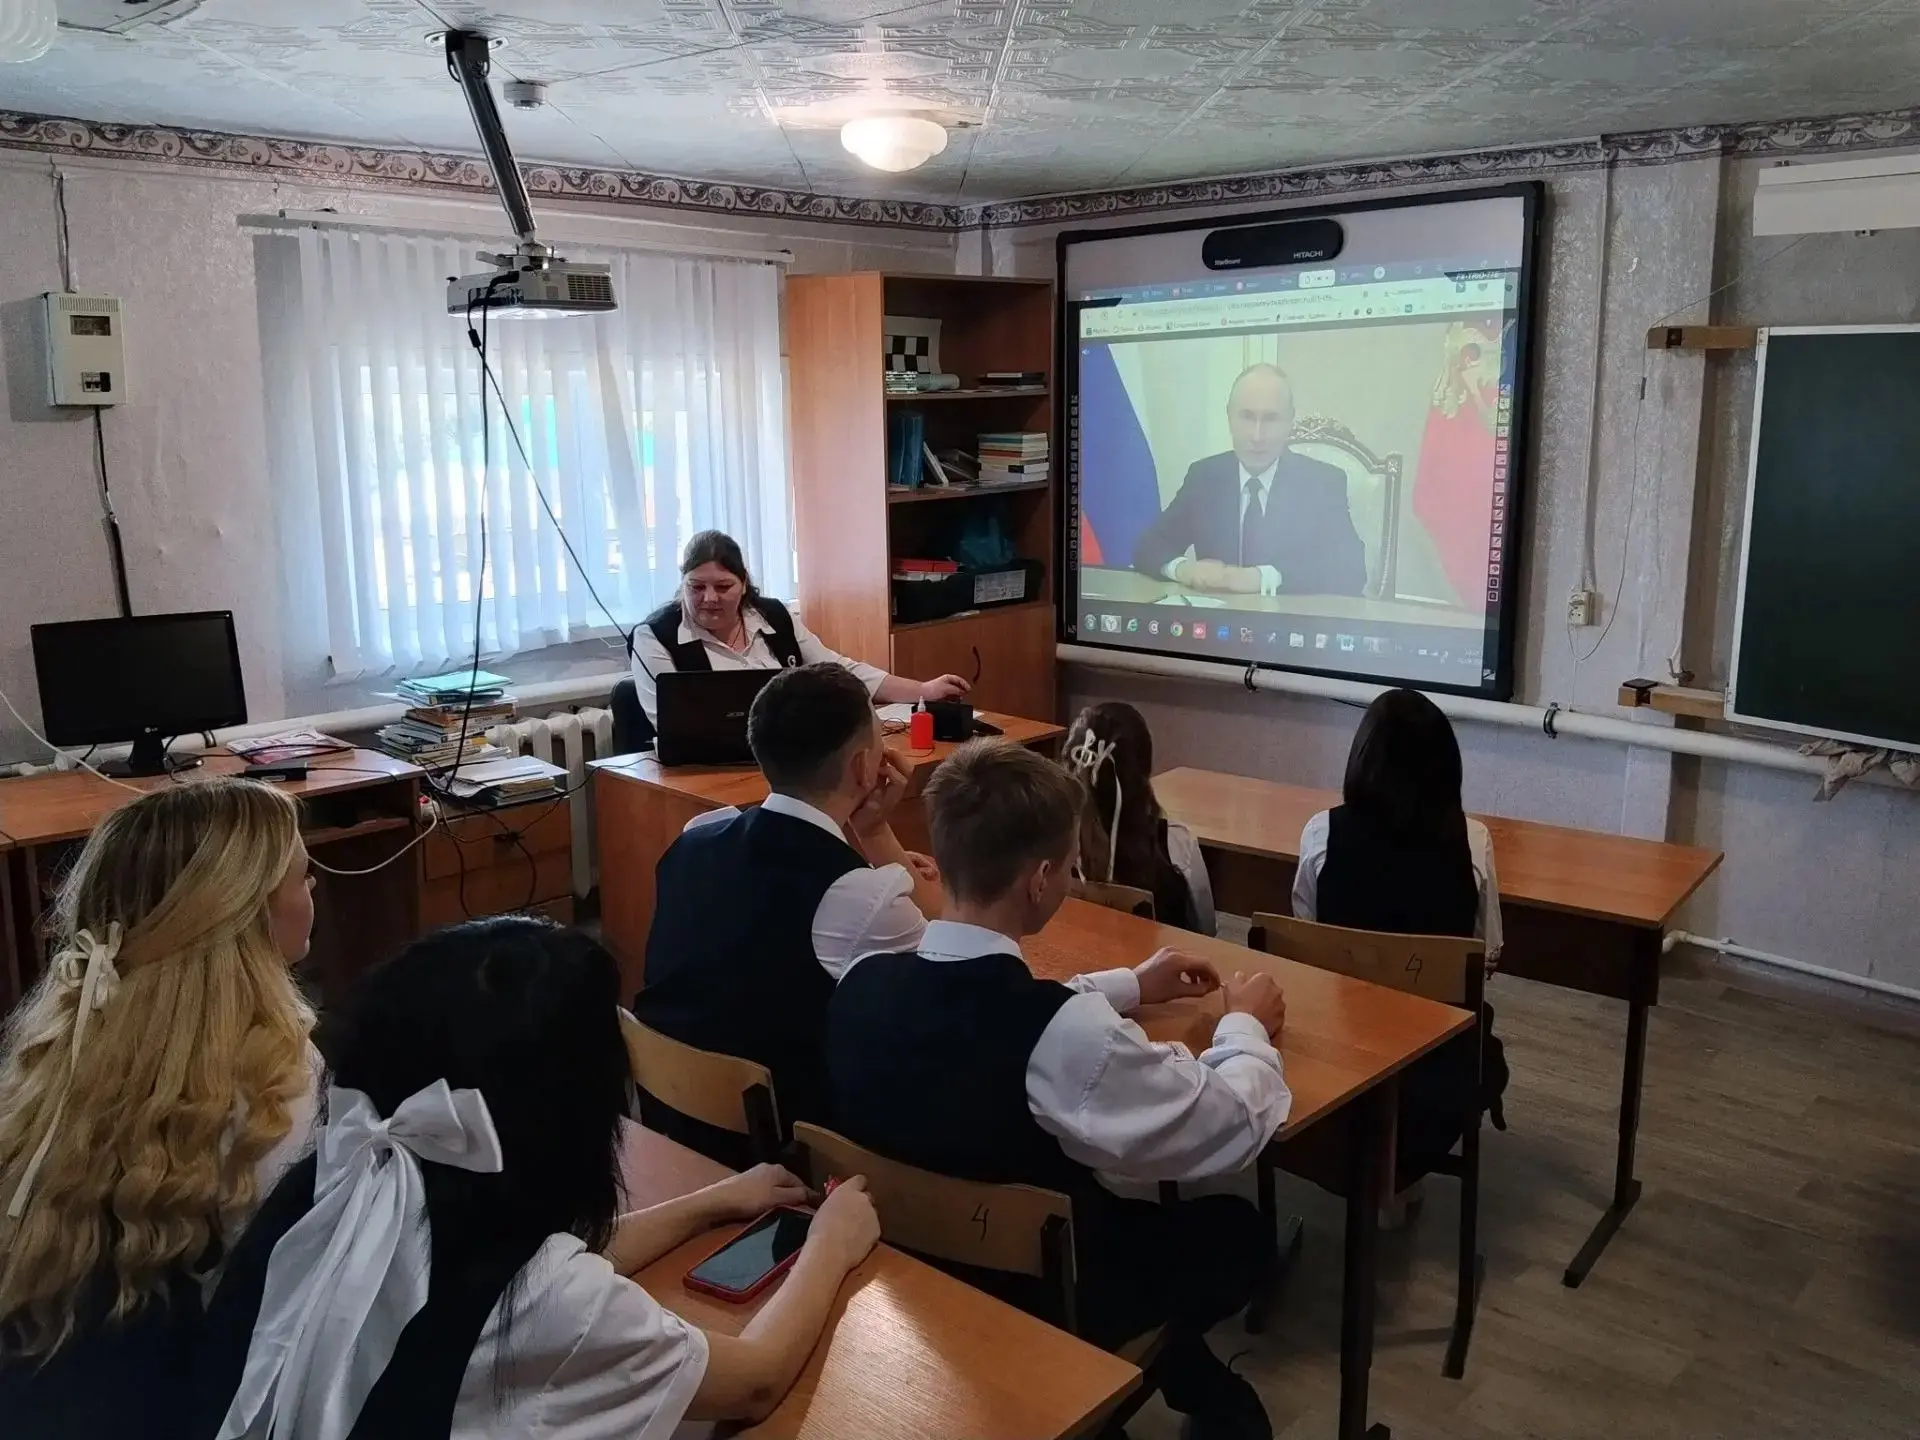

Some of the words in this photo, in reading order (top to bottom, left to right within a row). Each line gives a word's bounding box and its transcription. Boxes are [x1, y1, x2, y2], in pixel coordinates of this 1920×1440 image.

[1293, 249, 1324, 259] HITACHI
[1405, 952, 1423, 984] 4
[971, 1202, 990, 1243] 4
